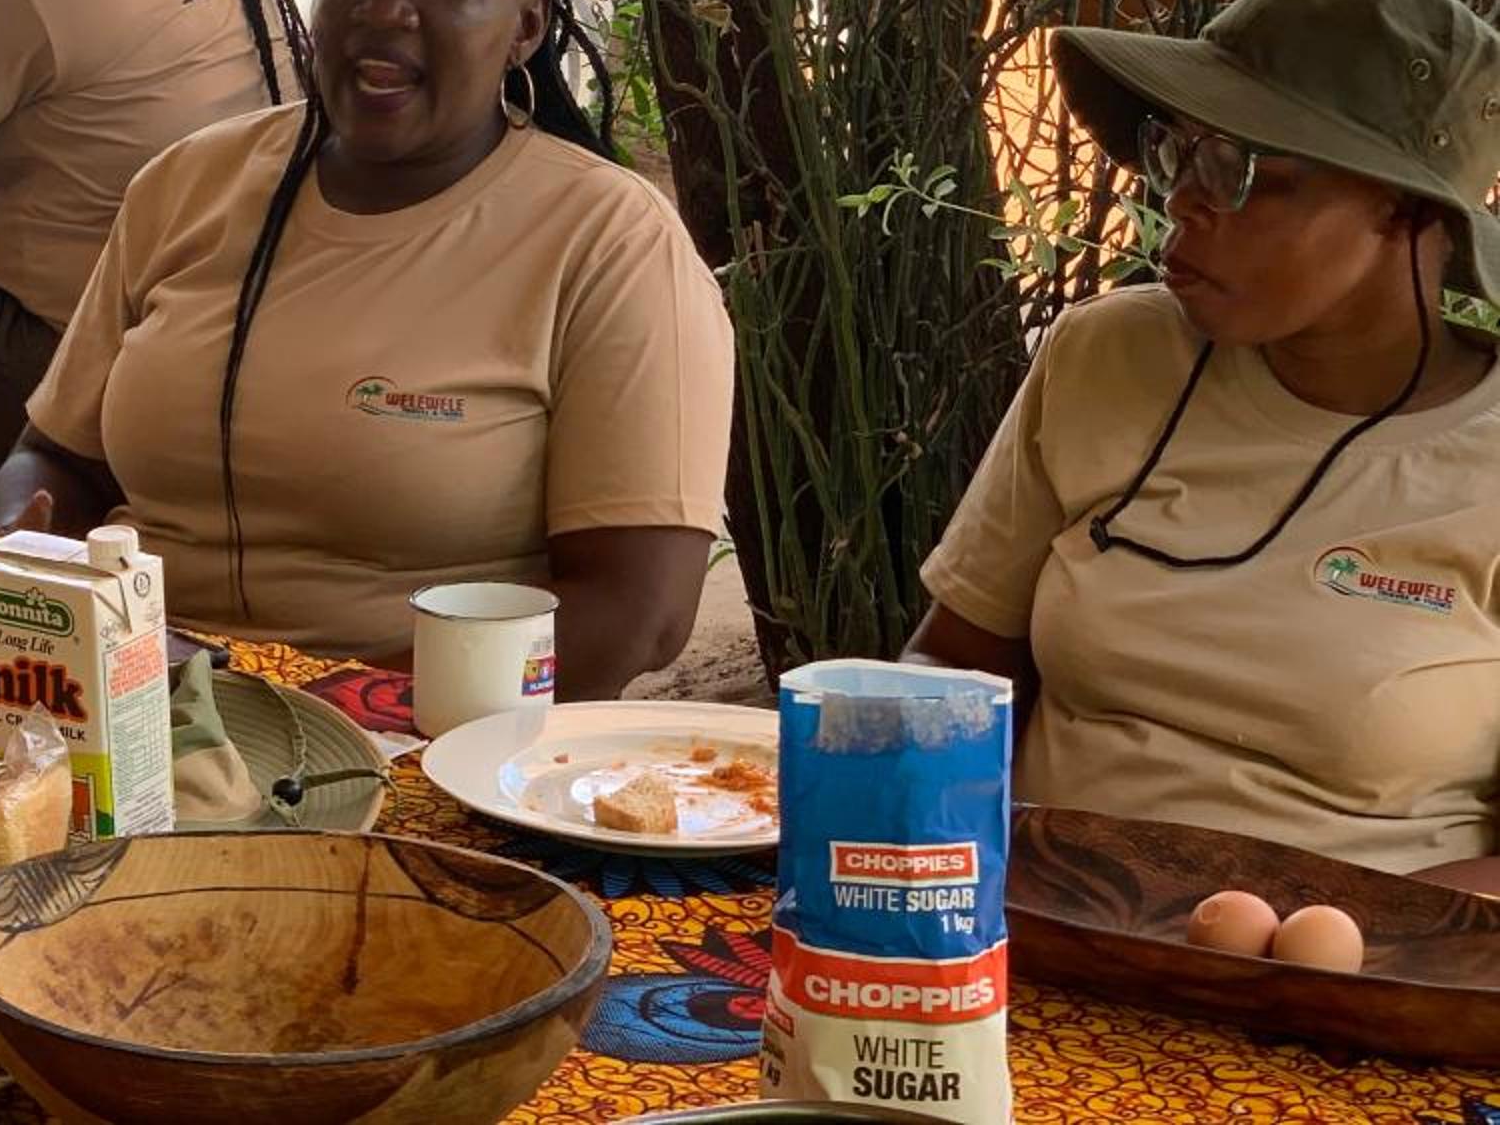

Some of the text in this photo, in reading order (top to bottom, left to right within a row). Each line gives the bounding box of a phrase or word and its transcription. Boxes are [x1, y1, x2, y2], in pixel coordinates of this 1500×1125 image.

[385, 392, 466, 412] WELEWELE
[1359, 572, 1456, 604] WELEWELE
[30, 636, 55, 655] Life
[845, 850, 965, 874] CHOPPIES
[834, 885, 976, 911] WHITE SUGAR
[941, 913, 975, 935] 1 kg
[803, 974, 996, 1012] CHOPPIES
[853, 1034, 945, 1070] WHITE
[852, 1066, 961, 1101] SUGAR
